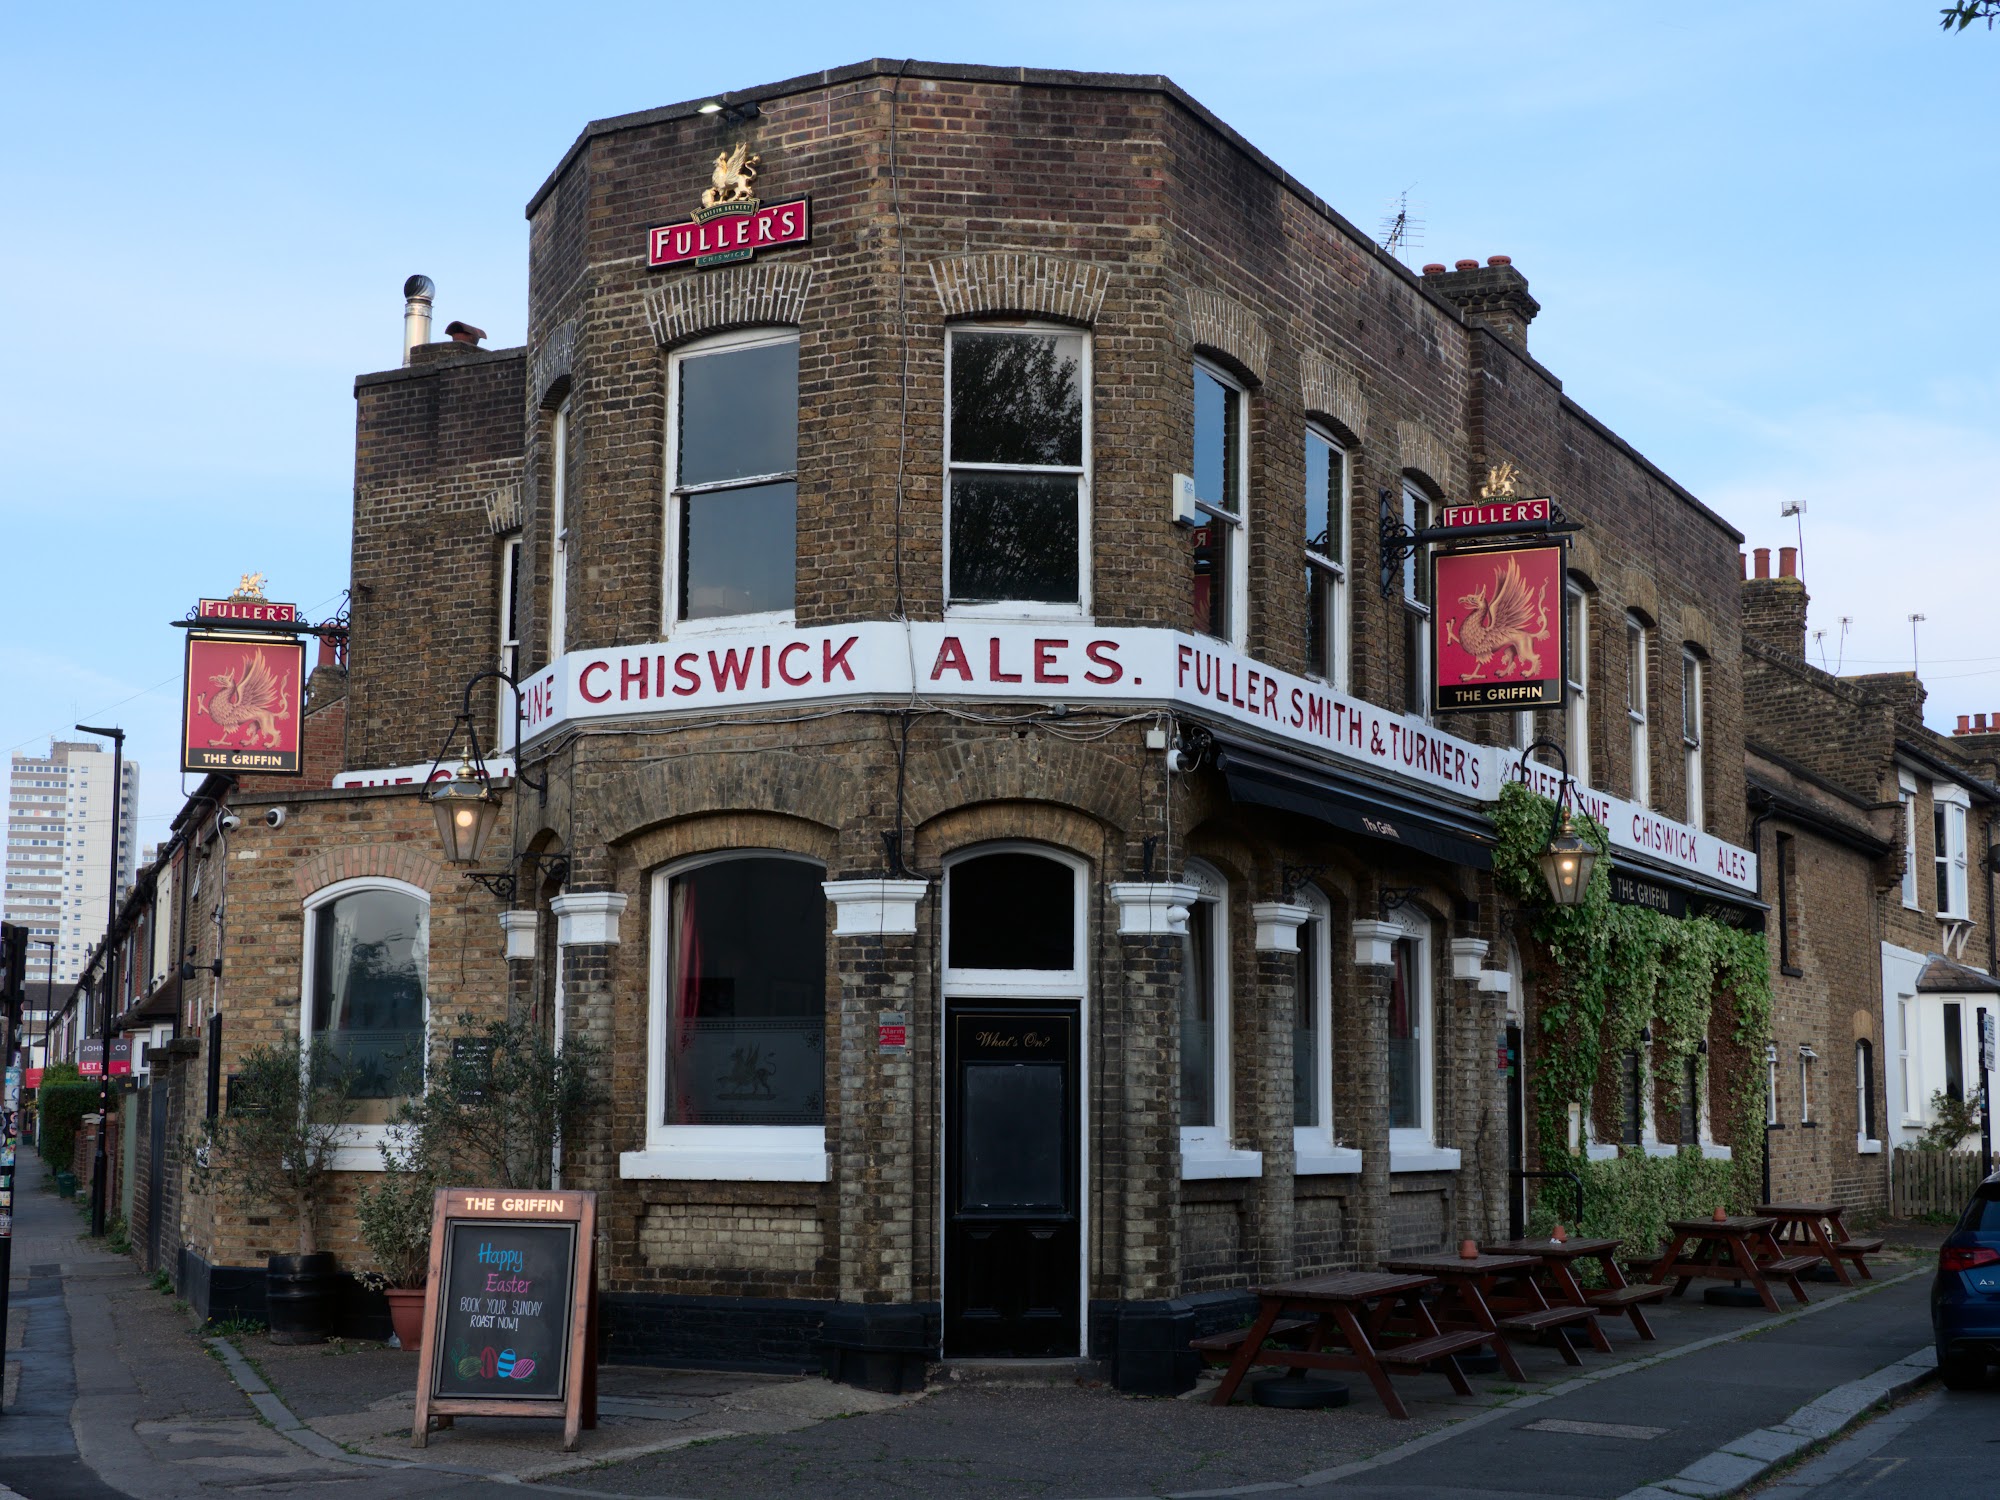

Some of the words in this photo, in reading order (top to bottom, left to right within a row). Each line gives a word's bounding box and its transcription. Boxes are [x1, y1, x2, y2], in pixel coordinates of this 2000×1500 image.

[724, 204, 751, 213] BREWERY
[655, 208, 796, 259] FULLER'S
[702, 250, 746, 263] CHISWICK
[1448, 502, 1544, 526] FULLER'S
[204, 602, 290, 622] FULLER'S
[578, 636, 860, 704] CHISWICK
[929, 636, 1143, 685] ALES.
[1455, 689, 1482, 702] THE
[1487, 686, 1544, 701] GRIFFIN
[1290, 688, 1362, 749] SMITH
[1370, 720, 1386, 756] &
[1389, 722, 1480, 790] TURNER'S
[203, 753, 227, 765] THE
[231, 754, 282, 766] GRIFFIN
[1632, 814, 1698, 864] CHISWICK
[1717, 846, 1746, 882] ALES
[1616, 877, 1635, 901] THE
[1636, 883, 1669, 910] GRIFFIN
[880, 1027, 905, 1035] Alarm
[975, 1031, 1019, 1047] What's
[1022, 1031, 1051, 1048] On?
[81, 1062, 97, 1070] LET
[465, 1197, 496, 1211] THE
[501, 1198, 564, 1213] GRIFFIN
[478, 1242, 523, 1273] Happy
[485, 1273, 533, 1294] Easter
[1979, 1278, 1995, 1286] A3
[460, 1296, 482, 1313] BOOK
[486, 1299, 507, 1316] YOUR
[511, 1300, 543, 1317] SUNDAY
[470, 1314, 496, 1329] ROAST
[497, 1317, 519, 1332] NOW!
